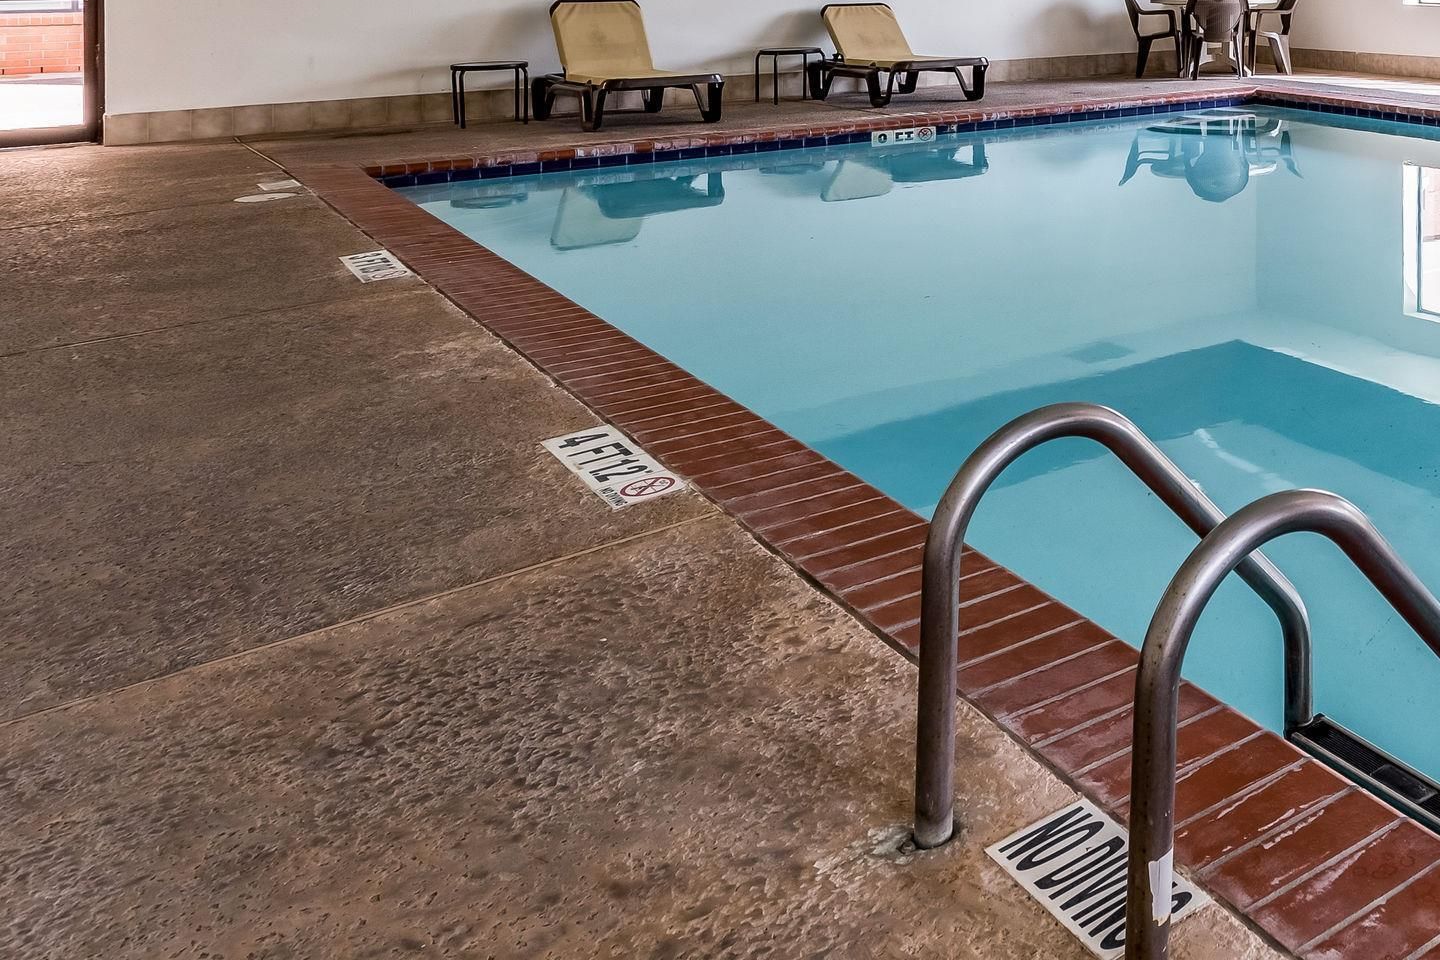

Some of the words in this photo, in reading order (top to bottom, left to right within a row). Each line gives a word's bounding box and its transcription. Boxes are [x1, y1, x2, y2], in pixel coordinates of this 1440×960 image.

[558, 432, 610, 448] 4
[566, 441, 634, 466] FT
[998, 806, 1105, 871] NO
